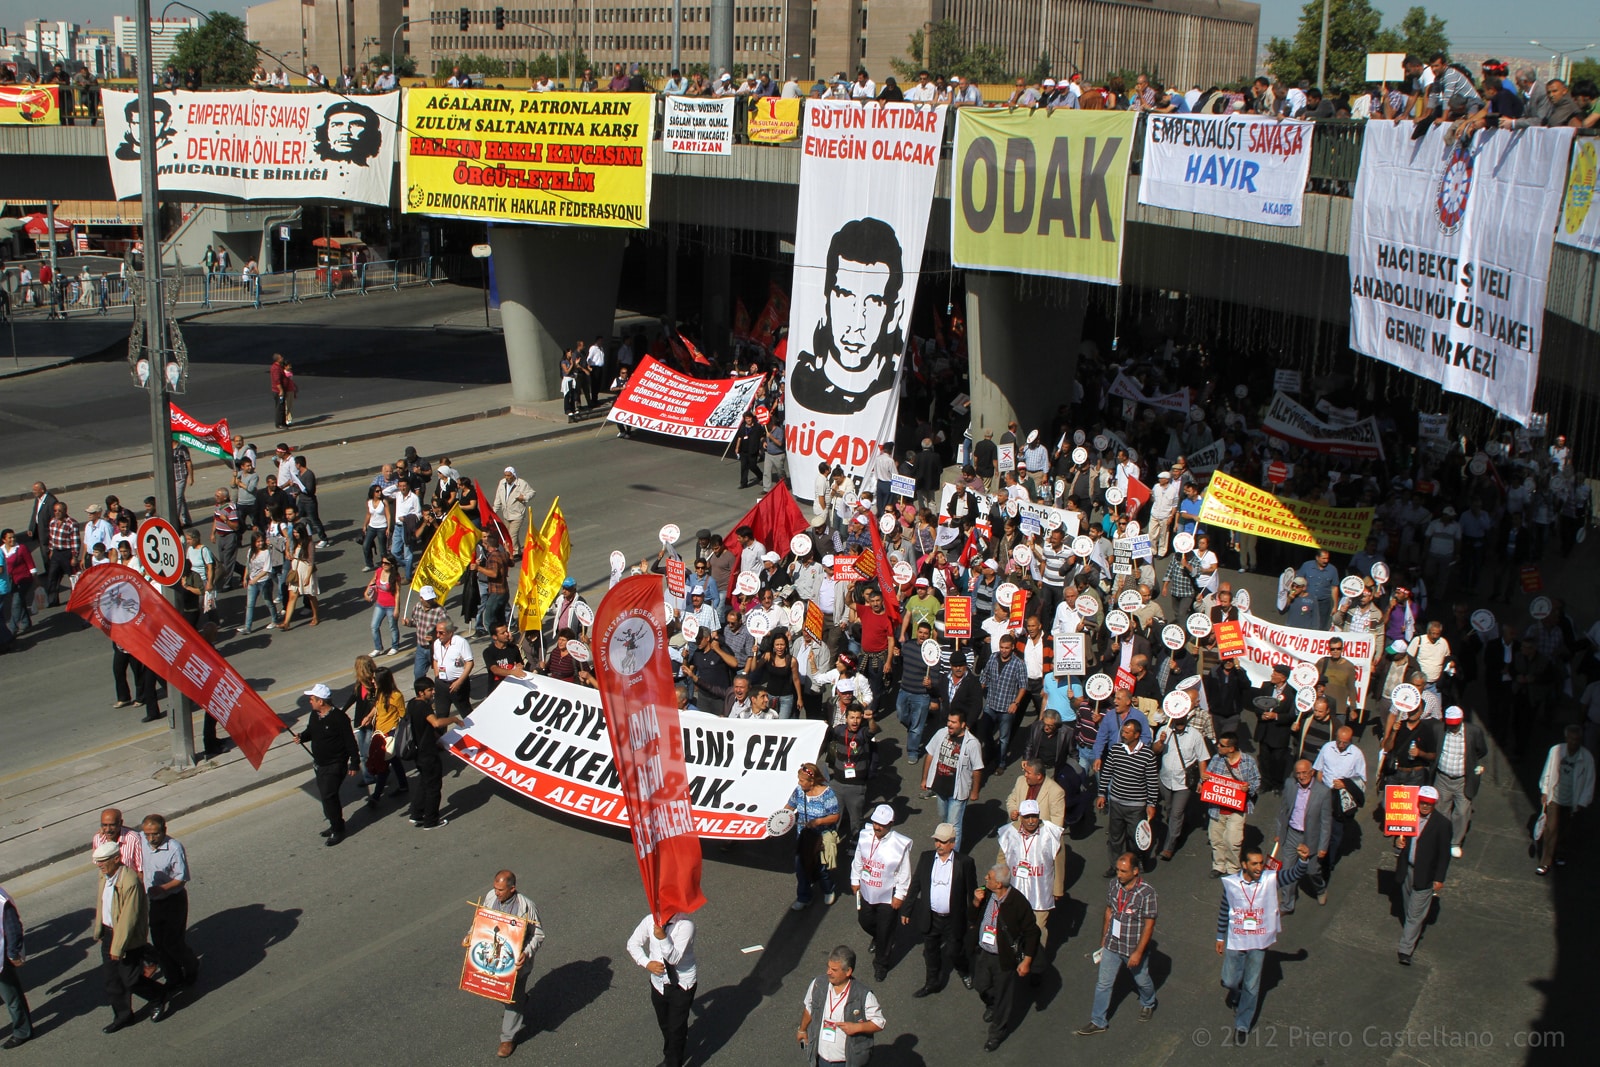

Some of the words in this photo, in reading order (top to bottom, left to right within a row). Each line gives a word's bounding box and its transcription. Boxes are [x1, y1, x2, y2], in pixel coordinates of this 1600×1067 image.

[425, 93, 516, 115] AĞALARIN,
[520, 99, 632, 116] PATRONLARIN
[811, 104, 866, 129] BÜTÜN
[415, 113, 471, 131] ZULÜM
[475, 117, 586, 137] SALTANATINA
[589, 121, 639, 142] KARŞI
[666, 129, 675, 138] BU
[669, 115, 692, 127] SAĞLAM
[692, 116, 707, 129] ÇARK
[186, 133, 250, 164] DEVRİM
[253, 137, 308, 165] ÖNLER!
[409, 137, 482, 159] HALKIN
[484, 140, 544, 162] HAKLI
[546, 143, 644, 167] KAVGASINI
[804, 134, 867, 161] EMEĞİN
[872, 139, 937, 166] OLACAK
[1152, 117, 1246, 151] EMPERYALİST
[1248, 123, 1303, 162] SAVAŞA
[158, 162, 260, 180] MÜCADELE
[264, 165, 329, 181] BİRLİĞİ
[453, 160, 596, 192] ÖRGÜTLEYELİM
[1184, 153, 1261, 193] HAYIR
[961, 136, 1123, 242] ODAK
[426, 192, 508, 213] DEMOKRATİK
[510, 196, 558, 217] HAKLAR
[559, 200, 643, 221] FEDERASYONU
[1377, 244, 1414, 273] HACI
[1480, 264, 1512, 301] VELİ
[1352, 275, 1423, 312] ANADOLU
[1385, 317, 1426, 352] GENEL
[614, 411, 693, 437] CANLARIN
[693, 426, 734, 441] YOLU
[1212, 490, 1271, 514] ÇORUM
[1213, 476, 1248, 498] GELİN
[1249, 492, 1296, 513] CANLAR
[1300, 506, 1321, 517] BİR
[1323, 510, 1370, 522] OLALIM
[1242, 521, 1256, 531] VE
[1257, 525, 1314, 544] DAYANIŞMA
[1268, 629, 1309, 651] KÜLTÜR
[741, 734, 797, 777] ÇEK
[463, 742, 538, 792] ADANA
[547, 782, 624, 818] ALEVİ
[1212, 784, 1237, 797] GERİ
[1203, 790, 1243, 808] İSTİYORUZ
